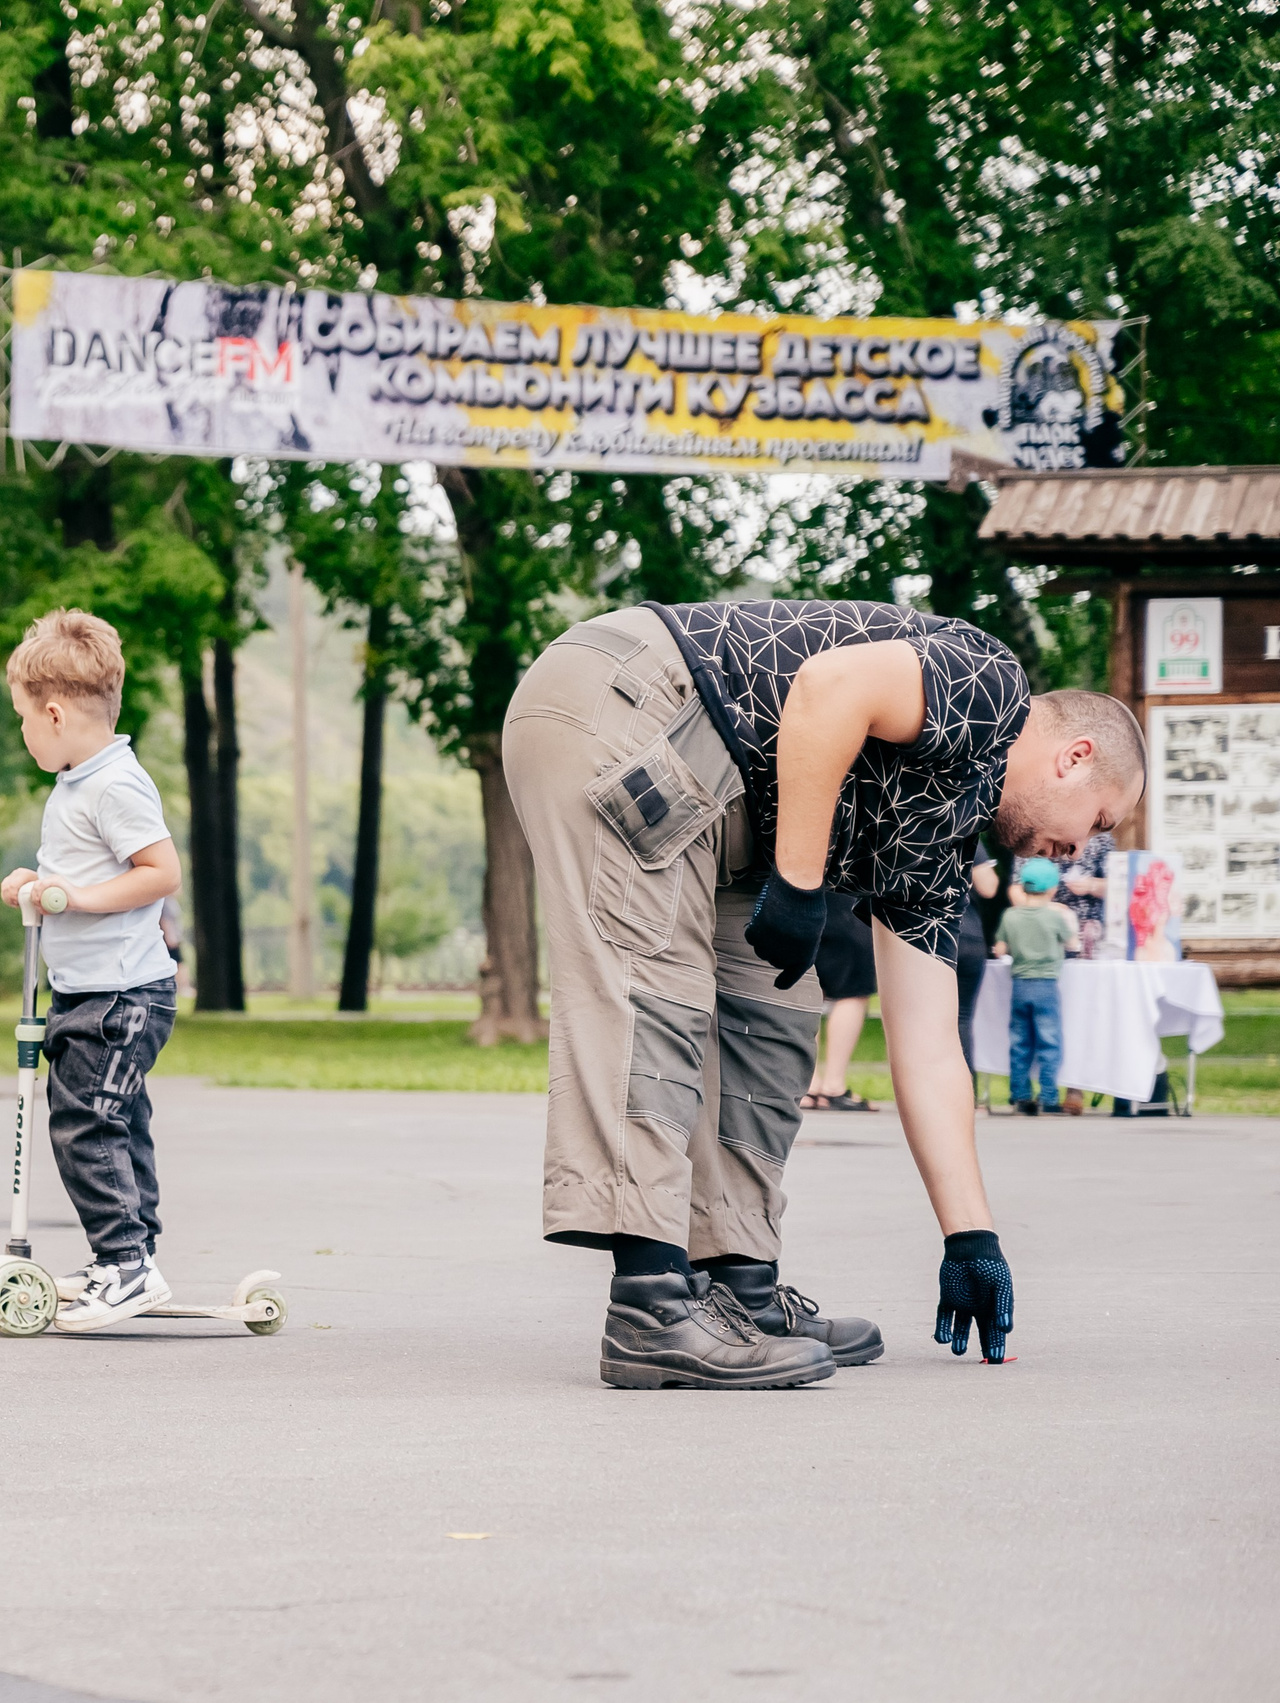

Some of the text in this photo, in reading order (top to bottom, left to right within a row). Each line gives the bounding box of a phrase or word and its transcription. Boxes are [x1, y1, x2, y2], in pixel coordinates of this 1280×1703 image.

[302, 304, 560, 366] СОБИРАЕМ
[573, 324, 763, 374] ЛУЧШЕЕ
[773, 332, 982, 380] ДЕТСКОЕ
[371, 356, 931, 424] КОМЬЮНИТИ КУЗБАССА
[1170, 629, 1200, 655] 99
